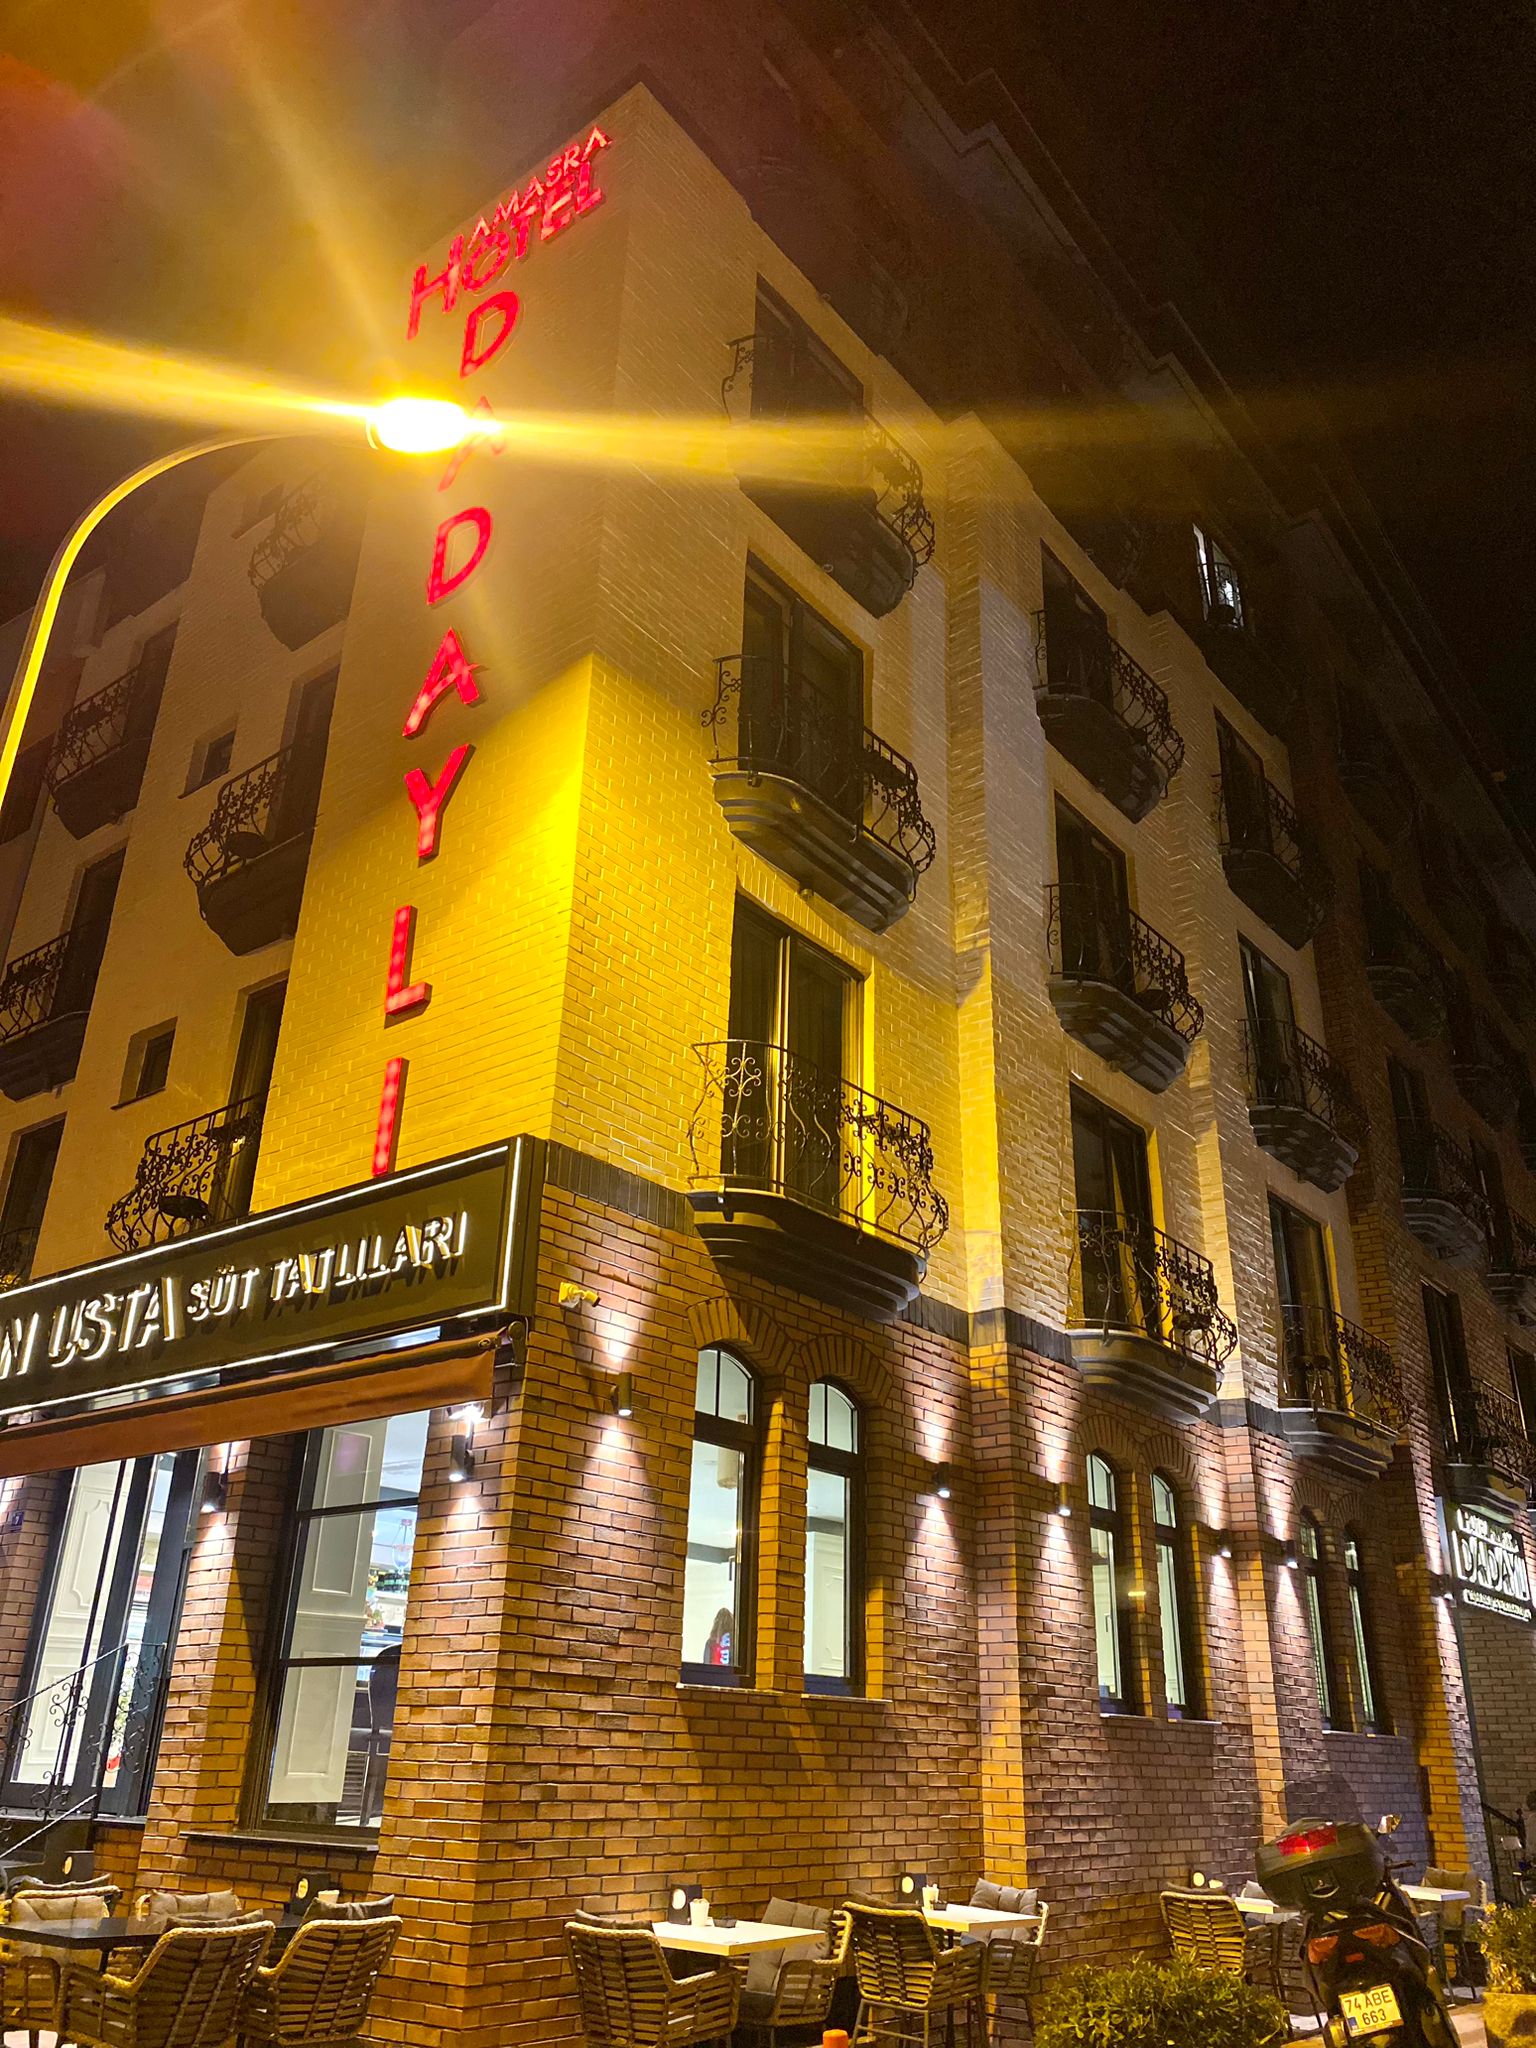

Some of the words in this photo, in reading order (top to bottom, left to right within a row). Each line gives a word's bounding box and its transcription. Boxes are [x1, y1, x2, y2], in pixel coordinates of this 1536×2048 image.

[467, 126, 612, 249] AMASRA
[407, 161, 602, 340] HOTEL
[49, 1277, 175, 1368] USTA
[187, 1265, 260, 1321] SÜT
[272, 1211, 467, 1301] TATLILARI
[1345, 1997, 1362, 2013] 74
[1365, 1989, 1392, 2008] ABE
[1361, 2008, 1387, 2026] 663
